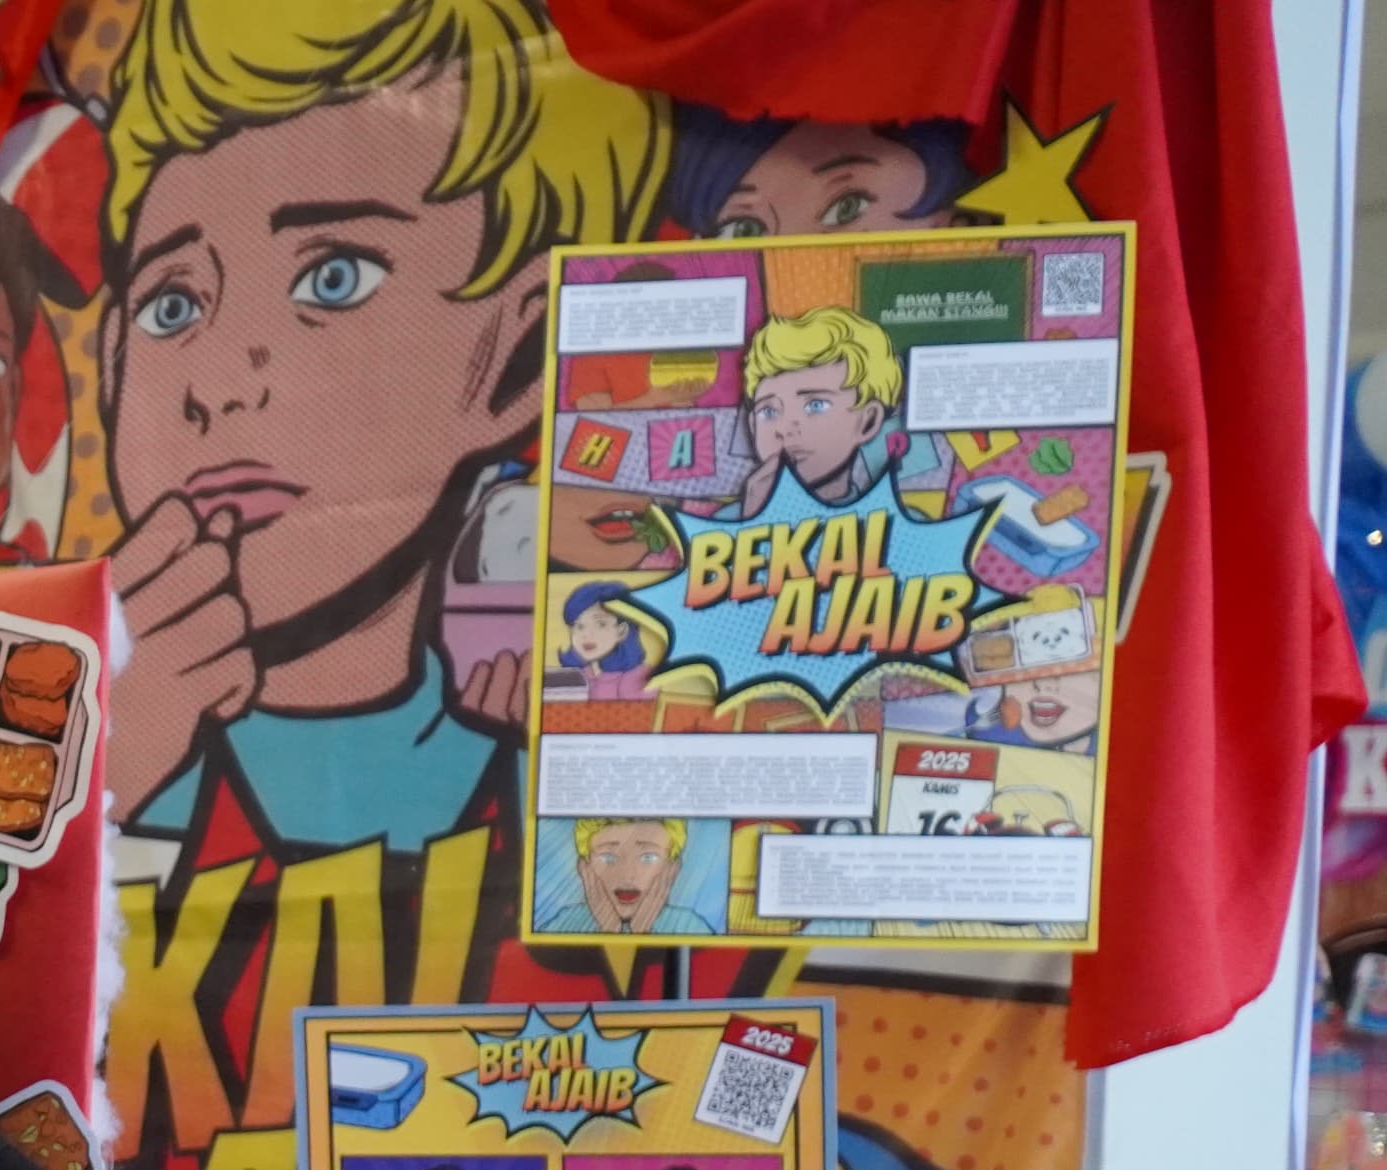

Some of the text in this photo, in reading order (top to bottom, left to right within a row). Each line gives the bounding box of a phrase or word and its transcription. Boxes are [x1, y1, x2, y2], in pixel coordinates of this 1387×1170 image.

[578, 432, 603, 467] H
[667, 429, 693, 470] A
[686, 511, 891, 607] BEKAL
[760, 575, 976, 655] AJAIB
[917, 750, 971, 773] 2025
[478, 1034, 587, 1086] BEKAL
[741, 1025, 795, 1056] 2025
[523, 1067, 638, 1114] AJAIB
